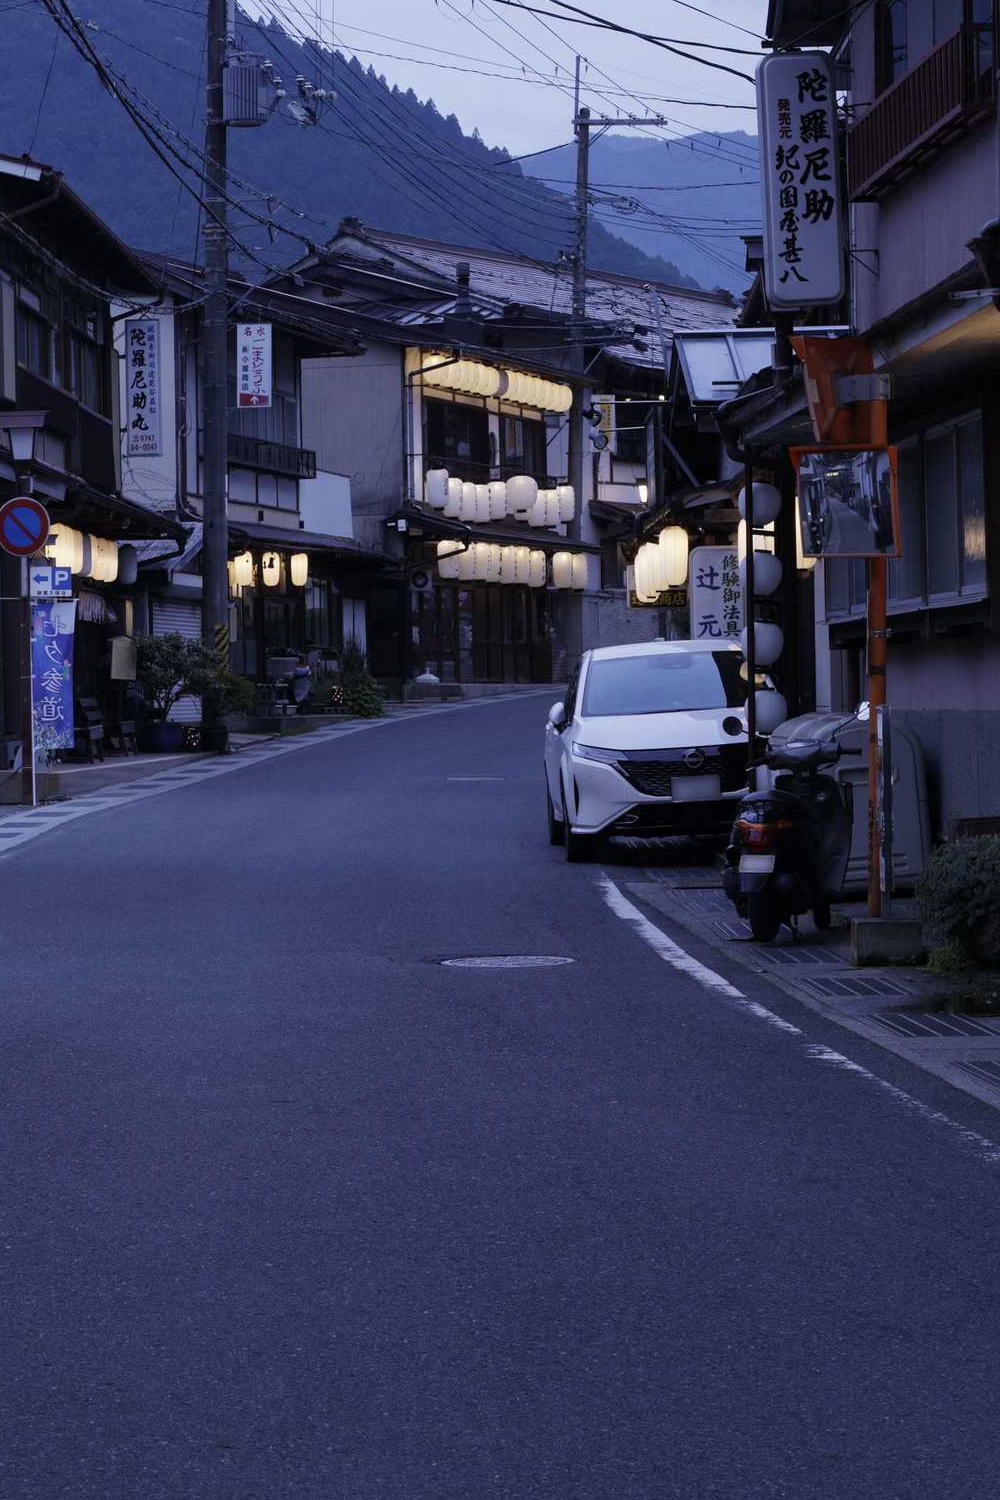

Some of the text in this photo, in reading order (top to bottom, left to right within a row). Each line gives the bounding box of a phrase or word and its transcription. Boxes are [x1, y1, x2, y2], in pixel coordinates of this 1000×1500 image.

[777, 98, 792, 140] 発売元
[795, 67, 835, 225] 陀羅尼助
[775, 144, 810, 284] 紀の国屋甚八
[129, 327, 150, 431] 陀羅尼助丸
[130, 443, 158, 452] 64-0047
[139, 434, 155, 442] 0747
[55, 570, 69, 586] P
[631, 591, 685, 606] 商店
